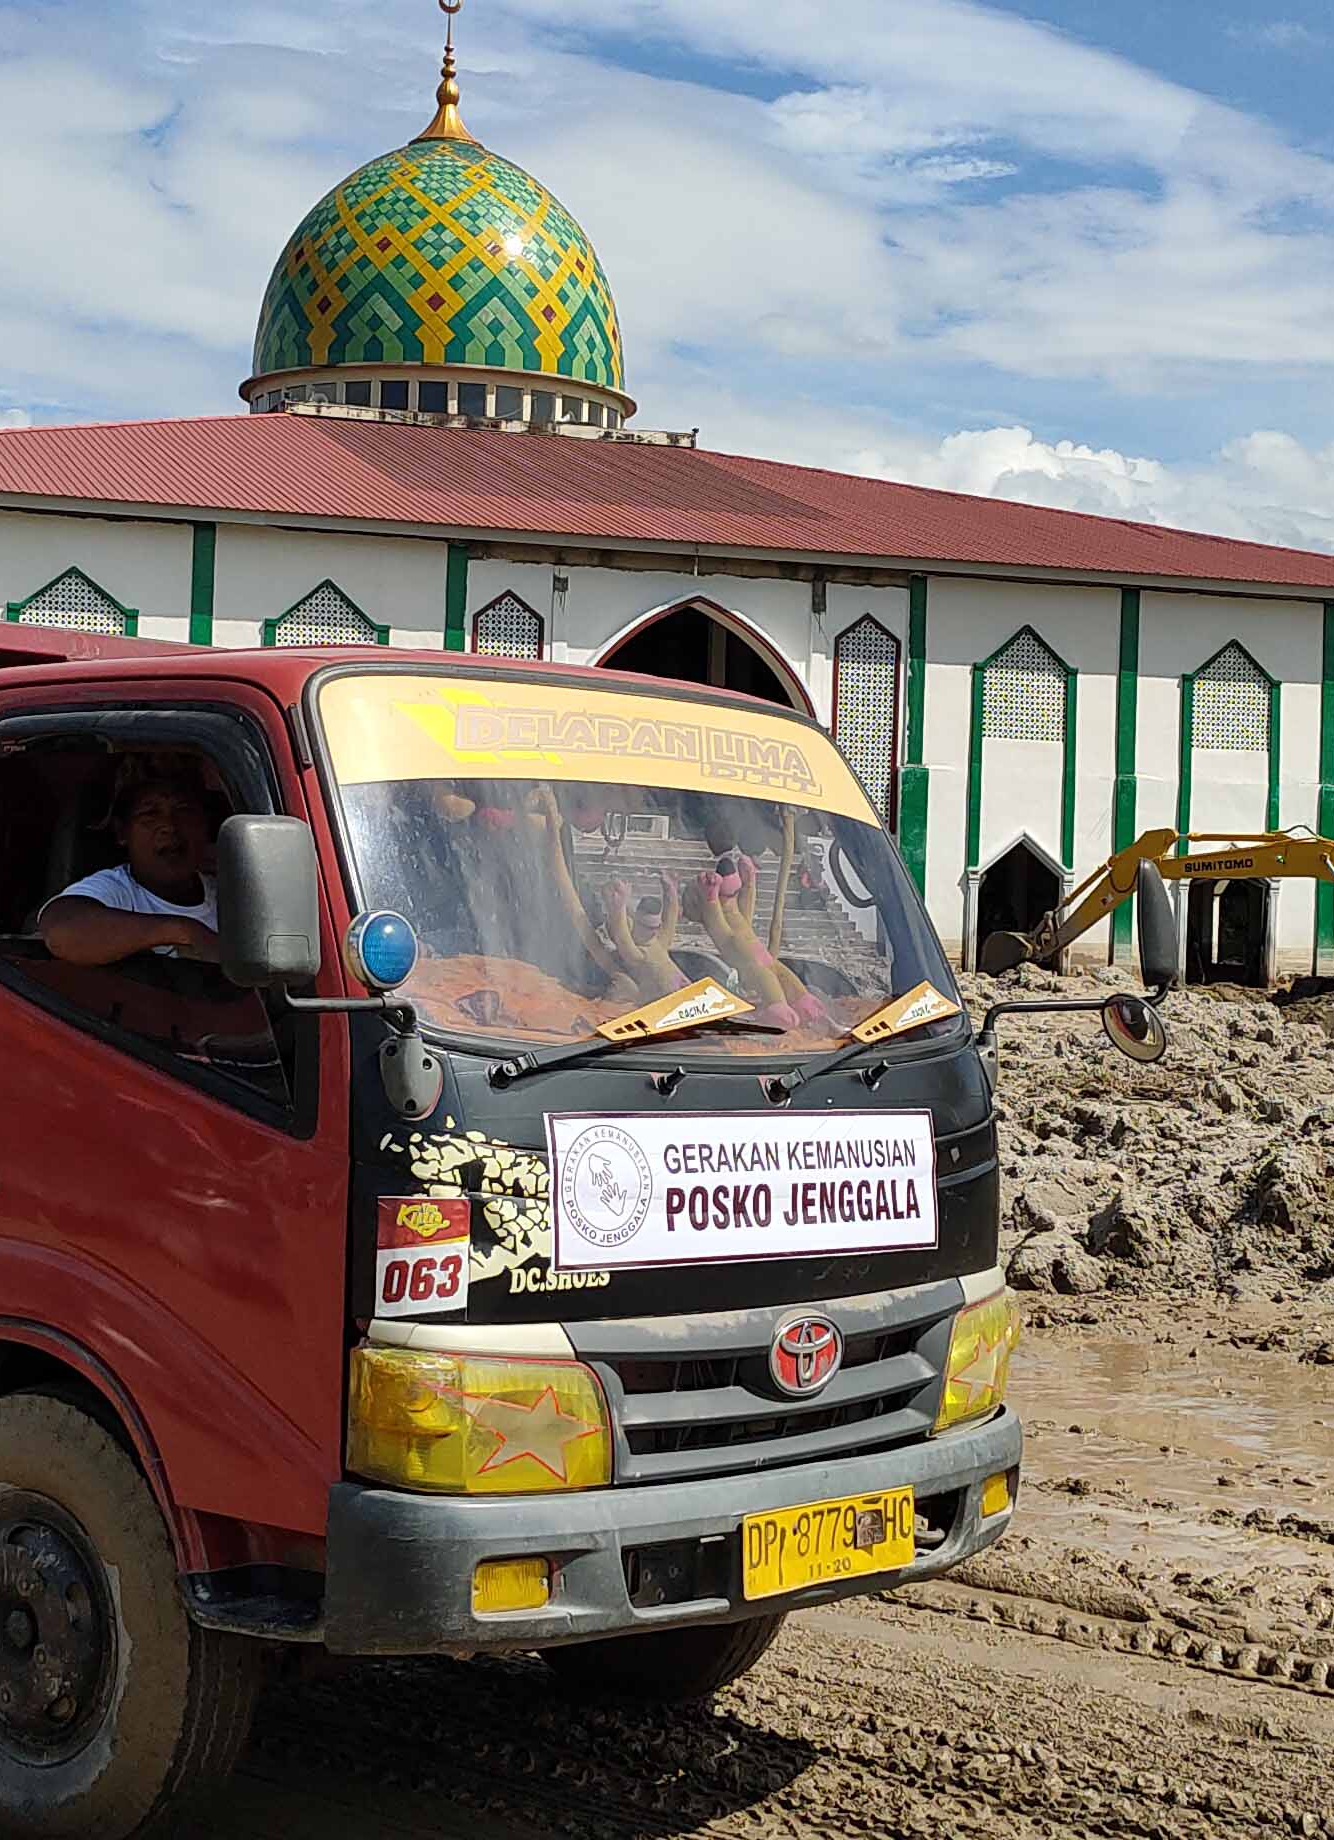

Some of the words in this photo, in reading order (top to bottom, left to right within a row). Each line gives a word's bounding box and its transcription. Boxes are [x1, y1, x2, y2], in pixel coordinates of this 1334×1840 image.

[456, 703, 701, 760] DELAPAN
[705, 727, 816, 783] LIMA
[1184, 858, 1254, 873] SUMITOMO
[564, 1136, 591, 1193] GERAKAN
[663, 1142, 780, 1174] GERAKAN
[787, 1139, 916, 1170] KEMANUSIAN
[566, 1199, 597, 1240] POSKO
[599, 1197, 648, 1243] JENGGALA
[666, 1183, 772, 1232] POSKO
[783, 1178, 921, 1227] JENGGALA
[381, 1254, 463, 1304] 063
[796, 1504, 858, 1558] 8779
[884, 1495, 912, 1542] HC
